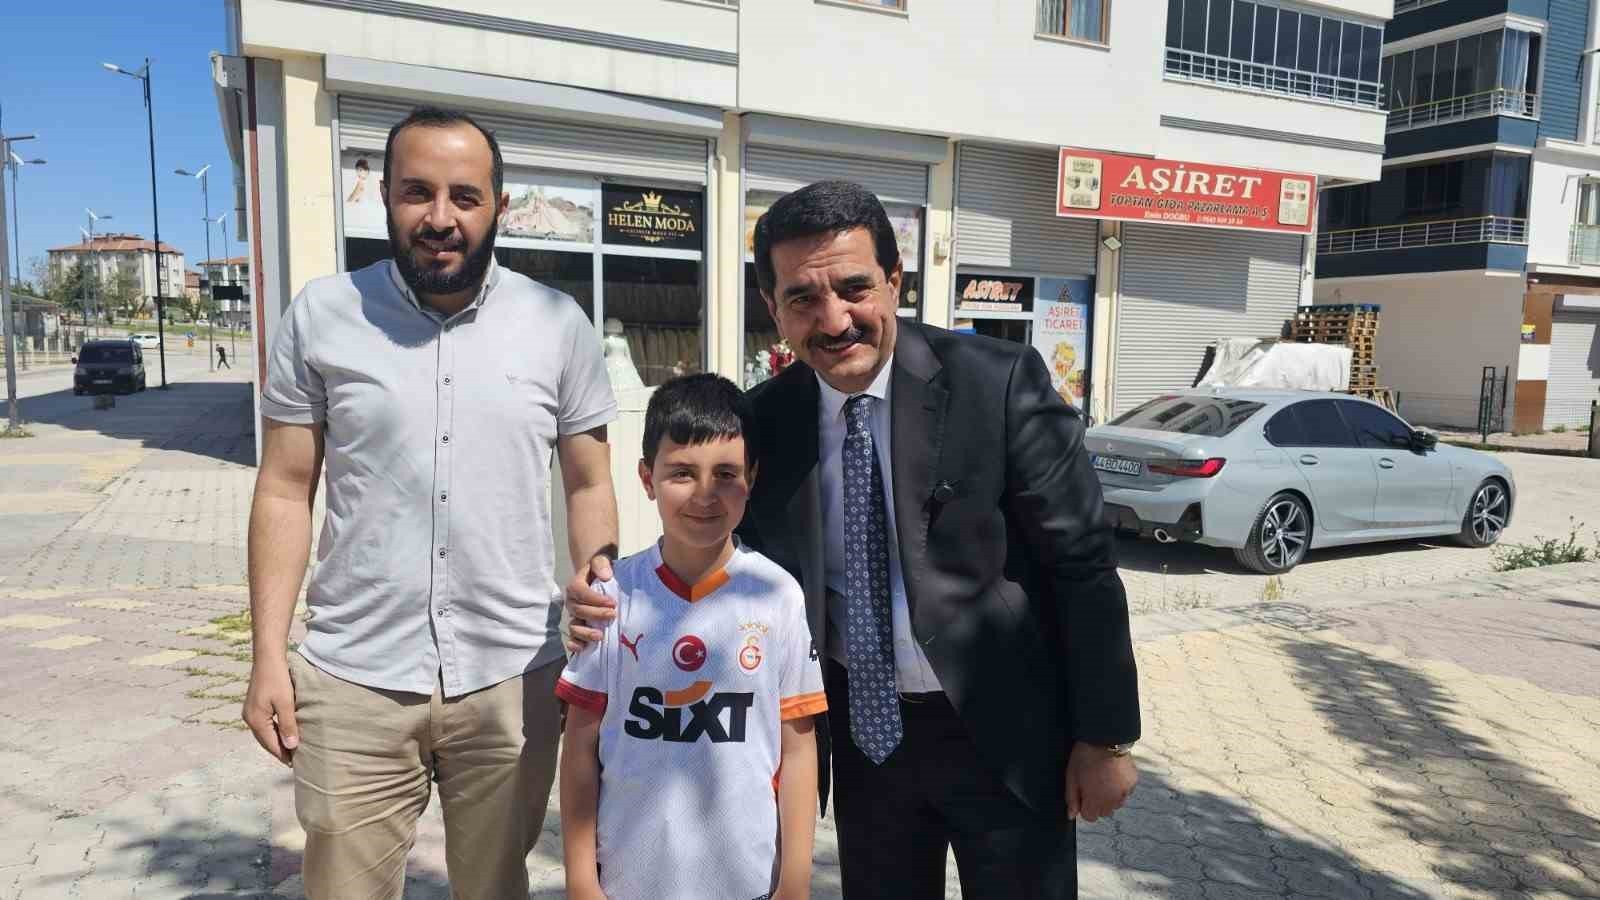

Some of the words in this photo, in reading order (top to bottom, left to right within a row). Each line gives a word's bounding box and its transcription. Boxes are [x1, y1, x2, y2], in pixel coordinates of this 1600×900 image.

[1119, 161, 1262, 199] AŞİRET
[1110, 194, 1153, 208] TOPTAN
[1156, 198, 1184, 210] GIDA
[1187, 200, 1250, 216] PAZARLAMA
[608, 213, 652, 229] HELEN
[655, 216, 695, 232] MODA
